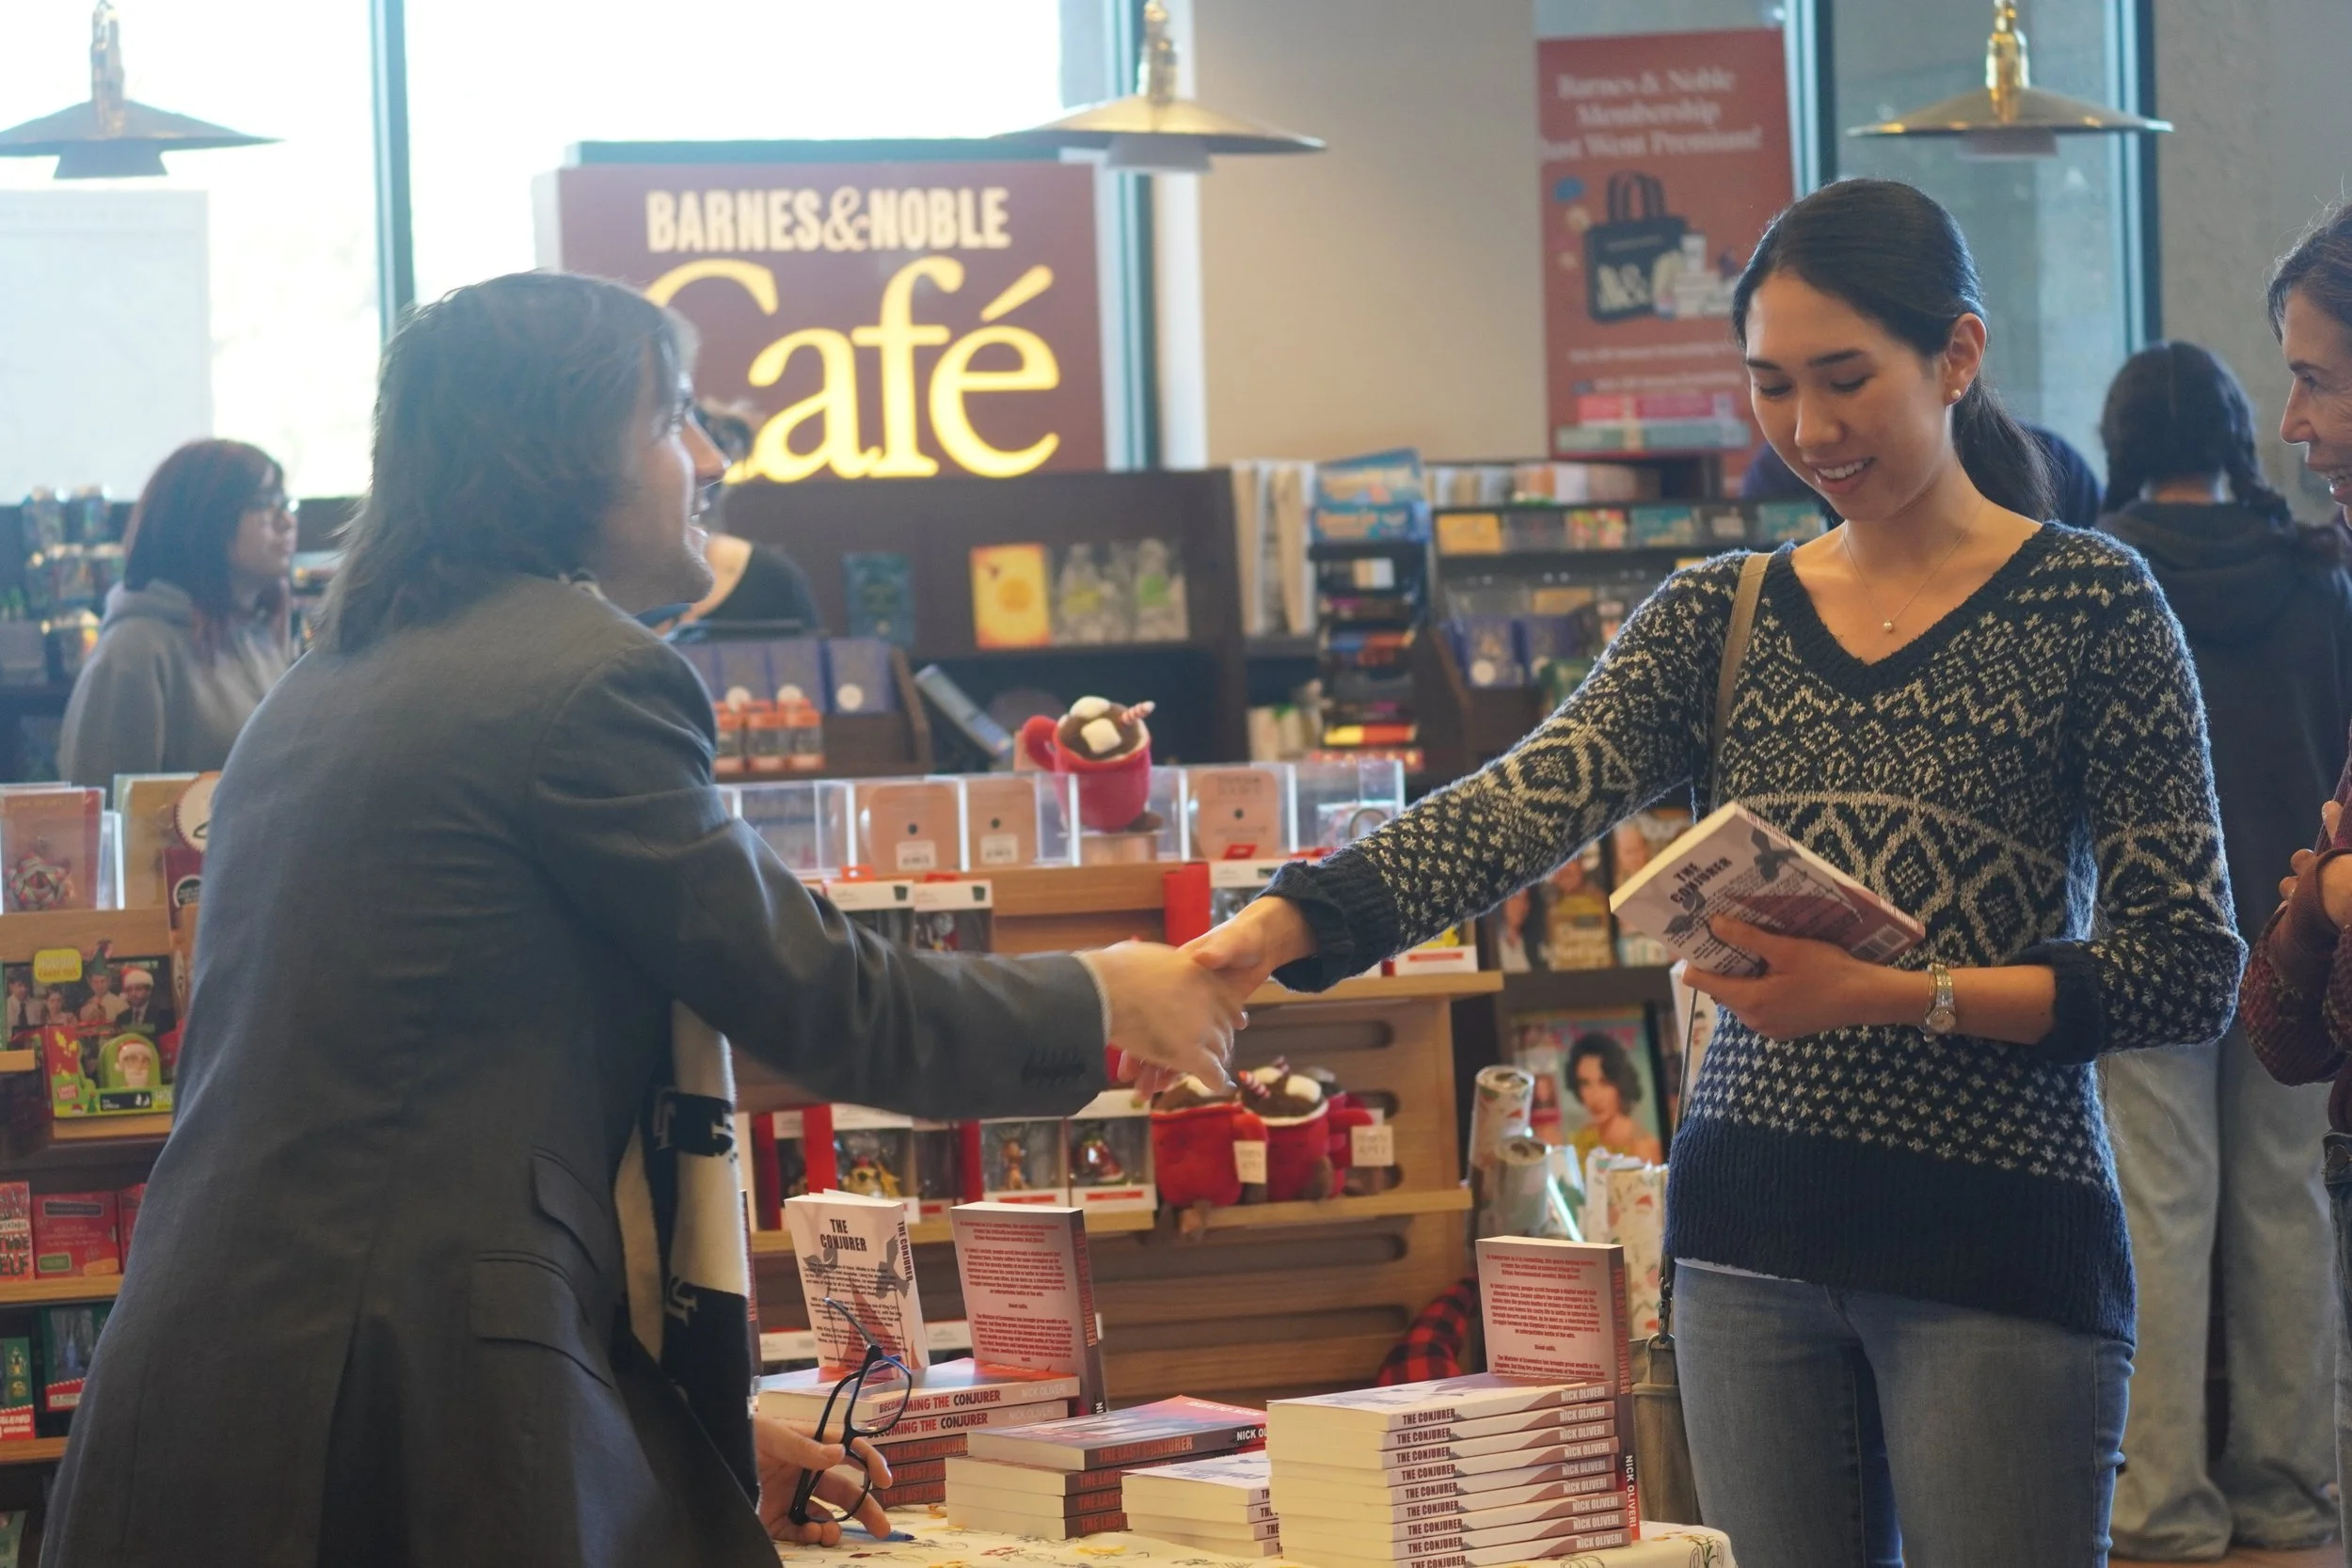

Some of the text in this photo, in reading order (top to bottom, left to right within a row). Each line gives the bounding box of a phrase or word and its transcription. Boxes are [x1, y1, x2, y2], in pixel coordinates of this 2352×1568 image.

[1557, 71, 1637, 101] Barnes
[1667, 66, 1737, 92] Noble
[1576, 98, 1721, 128] Membership
[830, 1219, 848, 1233] THE
[820, 1234, 867, 1252] CONJURER
[898, 1221, 914, 1282] THE CONJURER
[1615, 1327, 1631, 1395] CONJURER
[933, 1395, 950, 1409] THE
[953, 1389, 1001, 1406] CONJURER
[1562, 1386, 1605, 1402] NICK OLIVERI
[919, 1418, 937, 1432] THE
[941, 1413, 988, 1430] CONJURER
[1403, 1408, 1455, 1425] THE CONJURER
[1560, 1407, 1605, 1422] NICK OLIVERI
[1236, 1429, 1257, 1442] NICK
[1396, 1428, 1451, 1445] THE CONJURER
[1560, 1425, 1605, 1441] NICK OLIVERI
[1098, 1436, 1193, 1463] THE LAST CONJURER
[1396, 1447, 1451, 1464] THE CONJURER
[1564, 1442, 1609, 1458] NICK OLIVERI
[1402, 1464, 1456, 1481] THE CONJURER
[1562, 1460, 1606, 1476] NICK OLIVERI
[1079, 1474, 1097, 1488] THE
[1564, 1479, 1607, 1494] NICK OLIVERI
[1406, 1482, 1458, 1499] THE CONJURER
[1626, 1455, 1637, 1528] NICK OLIVERI
[1079, 1496, 1097, 1511] THE
[1407, 1500, 1458, 1517] THE CONJURER
[1573, 1496, 1618, 1513] NICK OLIVERI
[1081, 1517, 1100, 1532] THE
[1266, 1524, 1279, 1535] THE
[1407, 1518, 1462, 1535] THE CONJURER
[1573, 1514, 1619, 1530] NICK OLIVERI
[1407, 1537, 1463, 1554] THE CONJURER
[1577, 1533, 1622, 1549] NICK OLIVERI
[1427, 1556, 1466, 1568] CONJURER
